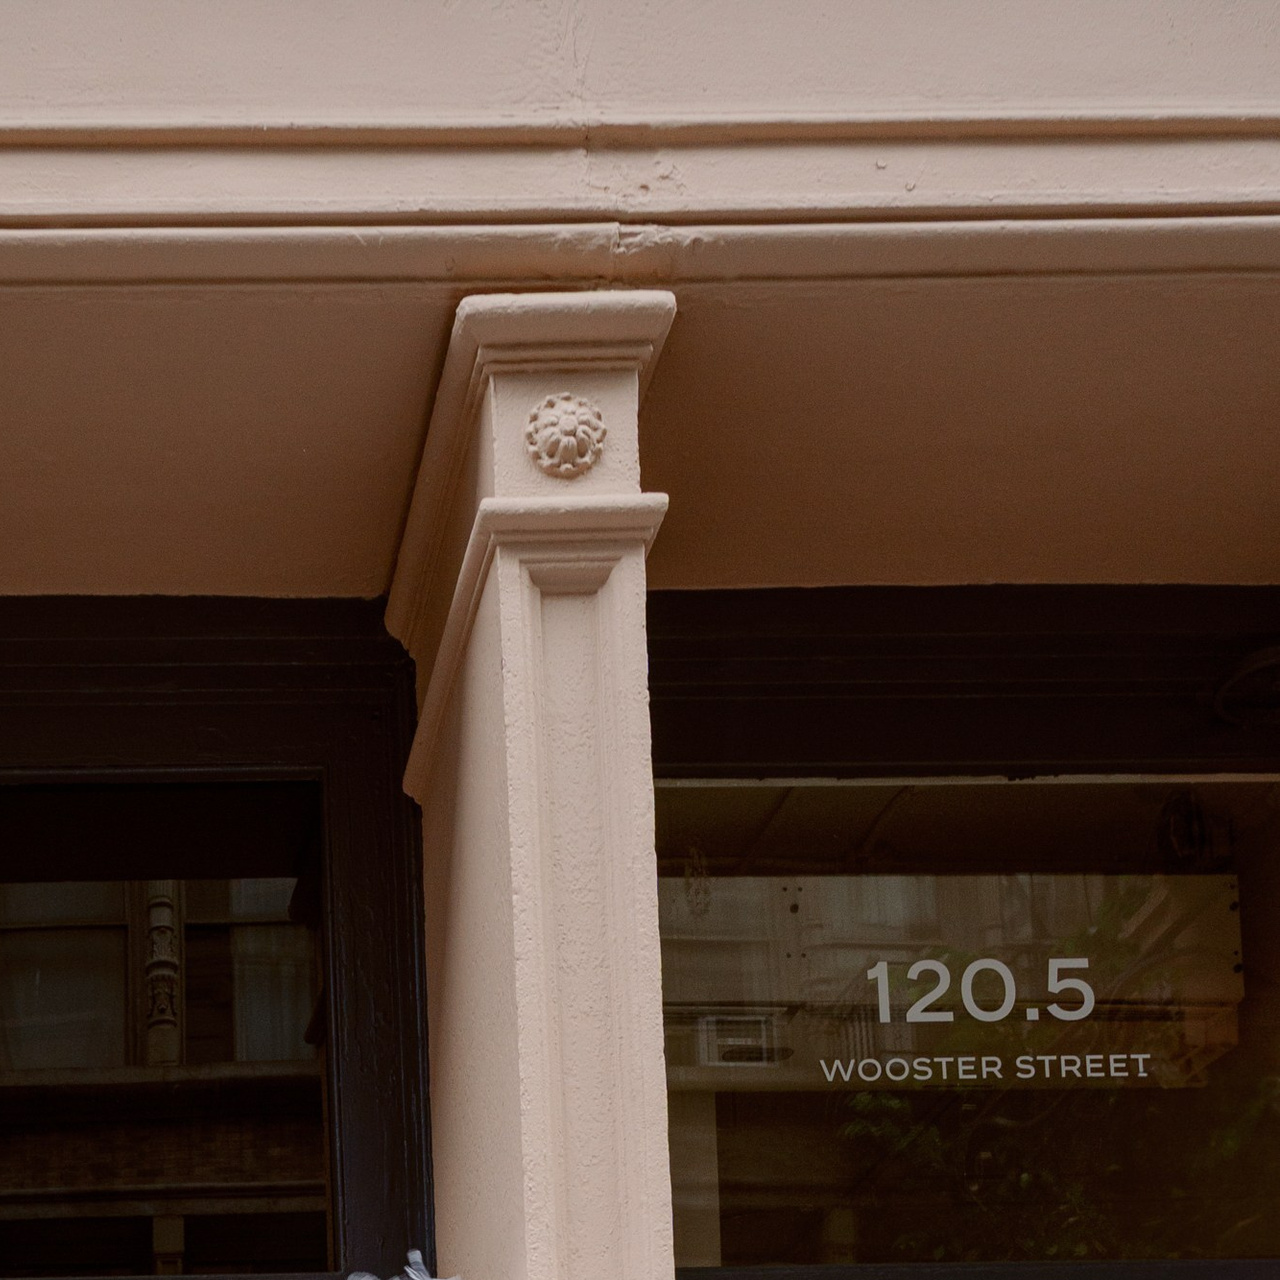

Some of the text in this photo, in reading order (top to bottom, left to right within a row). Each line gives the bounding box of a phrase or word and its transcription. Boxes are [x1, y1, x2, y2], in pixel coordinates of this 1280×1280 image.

[867, 957, 1095, 1024] 120.5
[819, 1053, 1151, 1082] WOOSTER STREET
